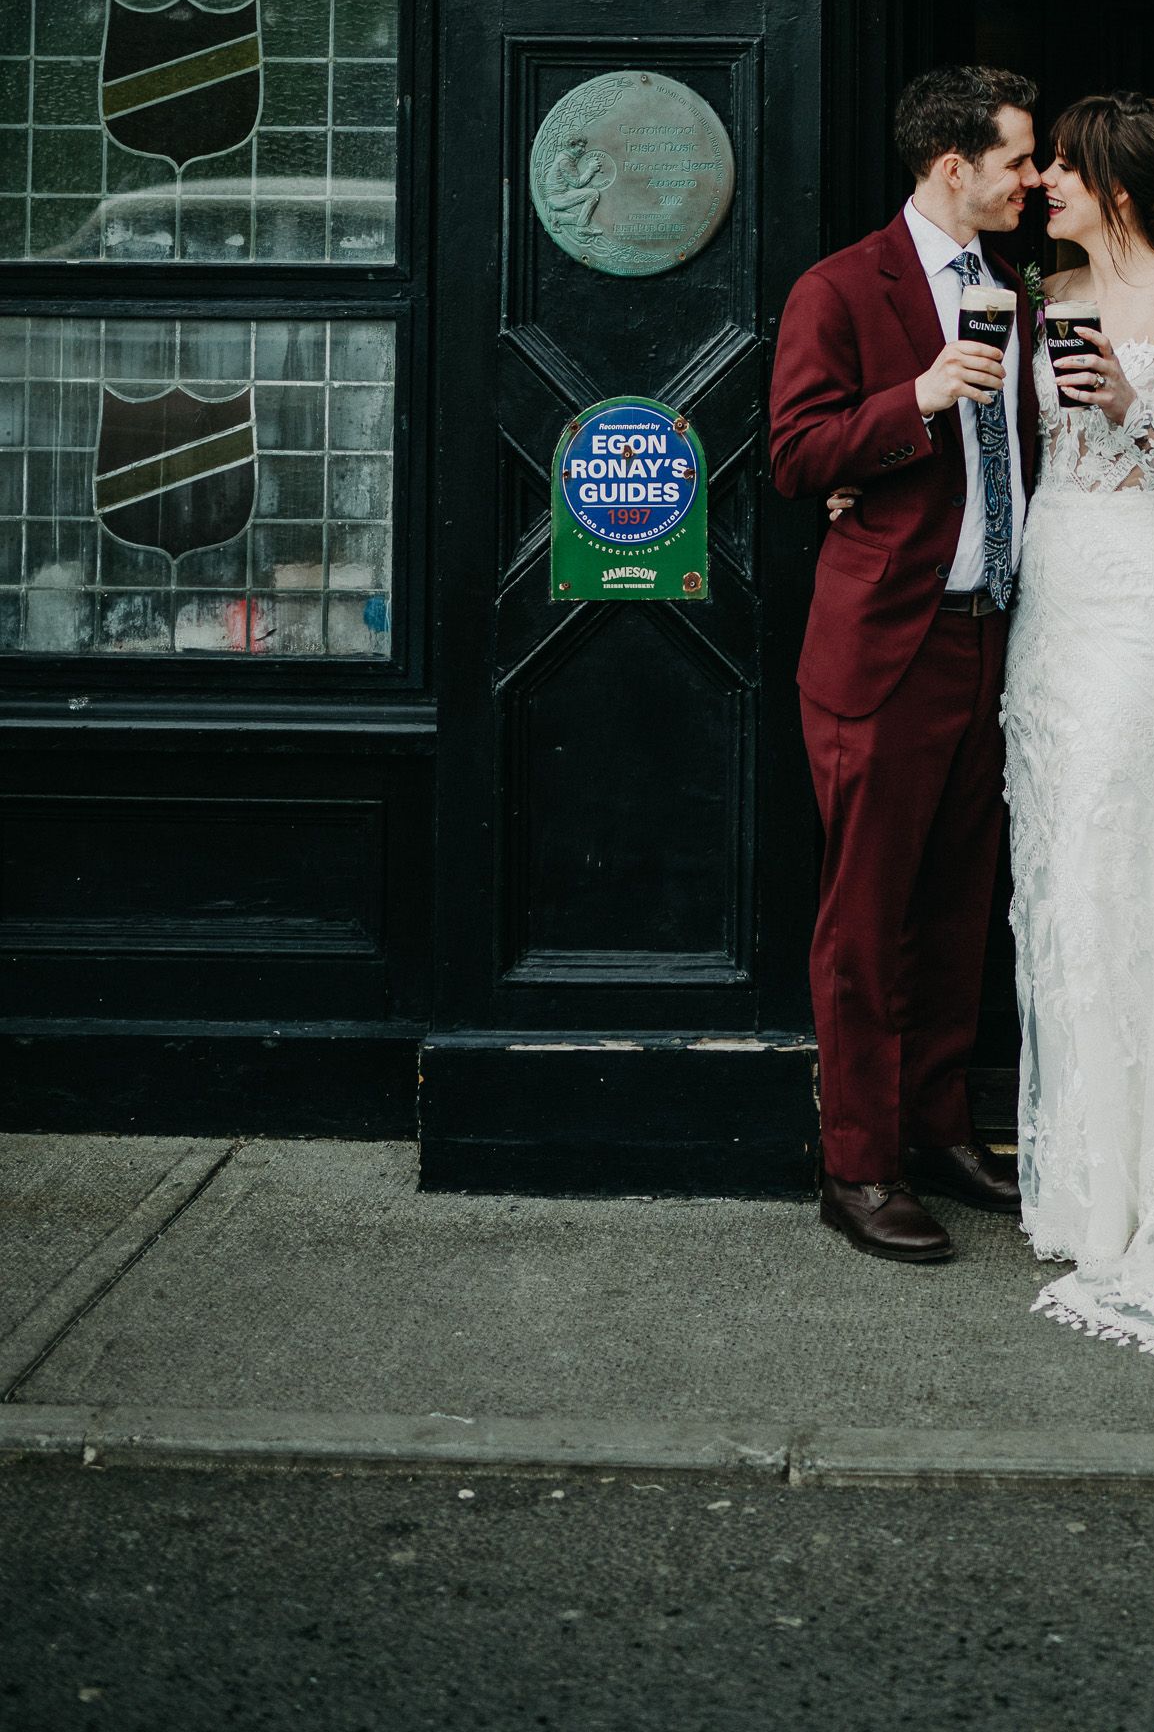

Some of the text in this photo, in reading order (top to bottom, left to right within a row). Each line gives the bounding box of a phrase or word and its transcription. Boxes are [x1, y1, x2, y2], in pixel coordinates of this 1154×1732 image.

[969, 319, 1007, 333] GUINNESS
[1048, 338, 1084, 348] GUINNESS
[599, 423, 660, 431] Recommended by
[592, 434, 667, 455] EGON
[571, 458, 688, 479] RONAY'S
[579, 482, 680, 503] GUIDES
[577, 509, 680, 540] FOOD & ACCOMMODATION
[607, 509, 652, 525] 1997
[572, 528, 687, 556] IN ASSOCIATION WITH
[601, 567, 657, 582] JAMESON
